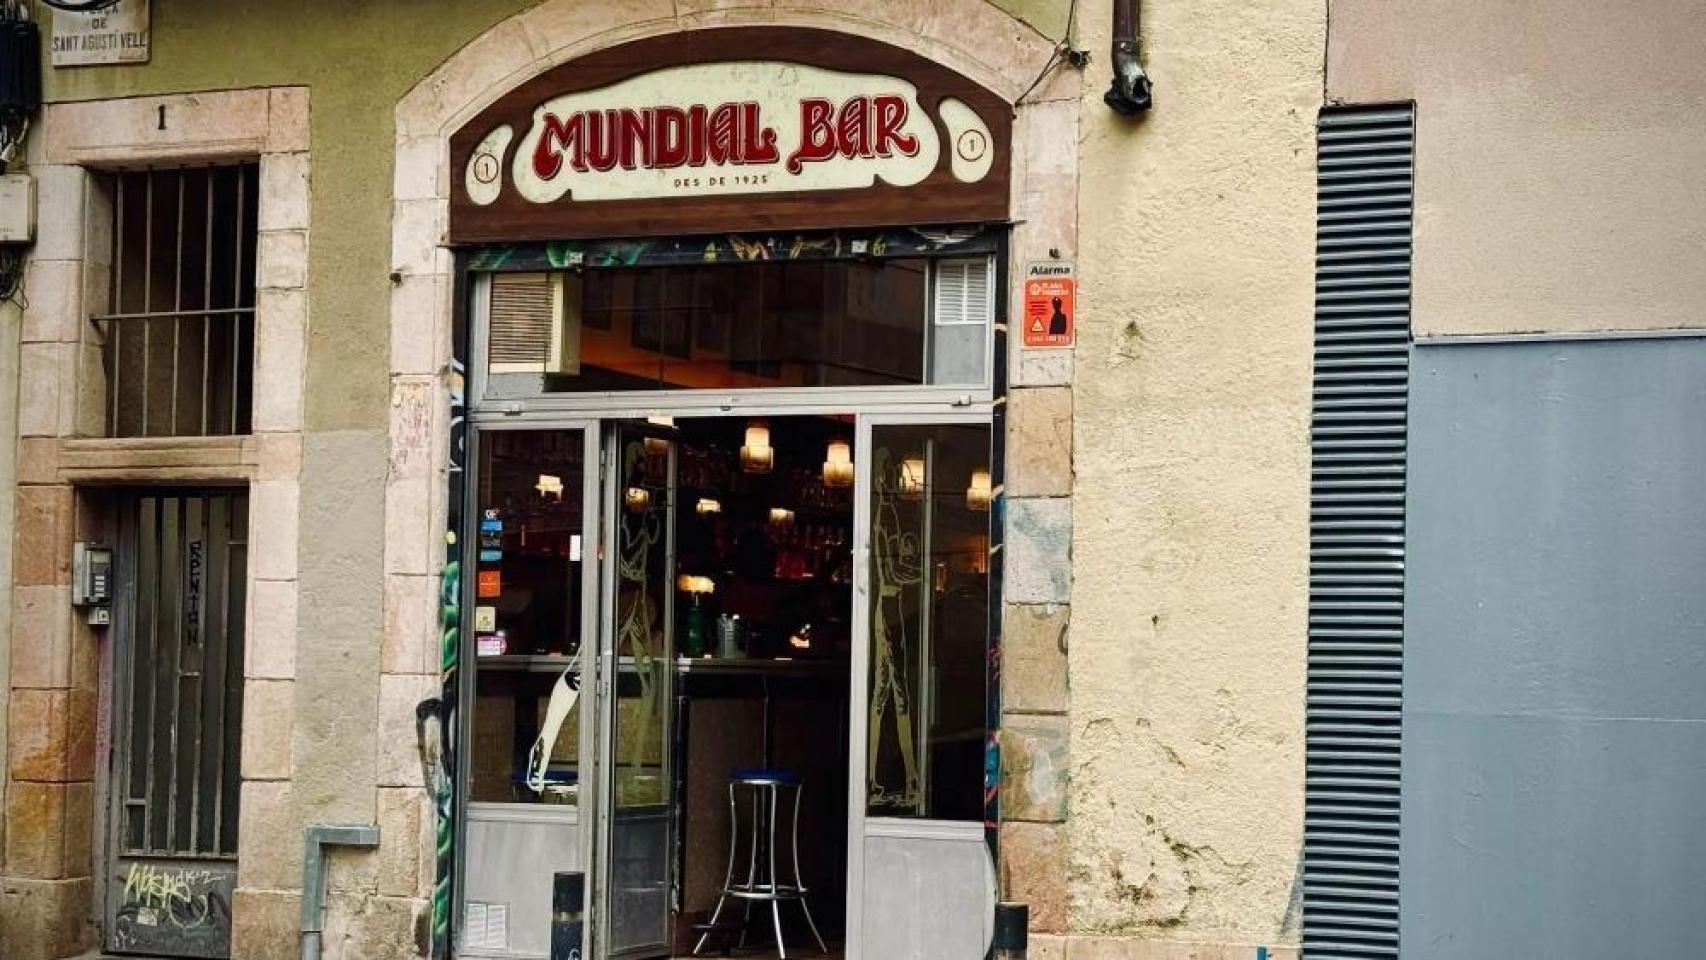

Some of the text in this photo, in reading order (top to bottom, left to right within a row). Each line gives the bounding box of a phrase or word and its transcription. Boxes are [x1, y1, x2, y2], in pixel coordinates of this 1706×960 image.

[91, 18, 107, 29] DE
[53, 34, 80, 51] SANT
[120, 31, 147, 48] VELL
[158, 104, 167, 130] 1
[532, 94, 921, 181] MUNDIAL BAR
[673, 174, 768, 188] DES DE 1925
[1030, 264, 1070, 276] Alarma
